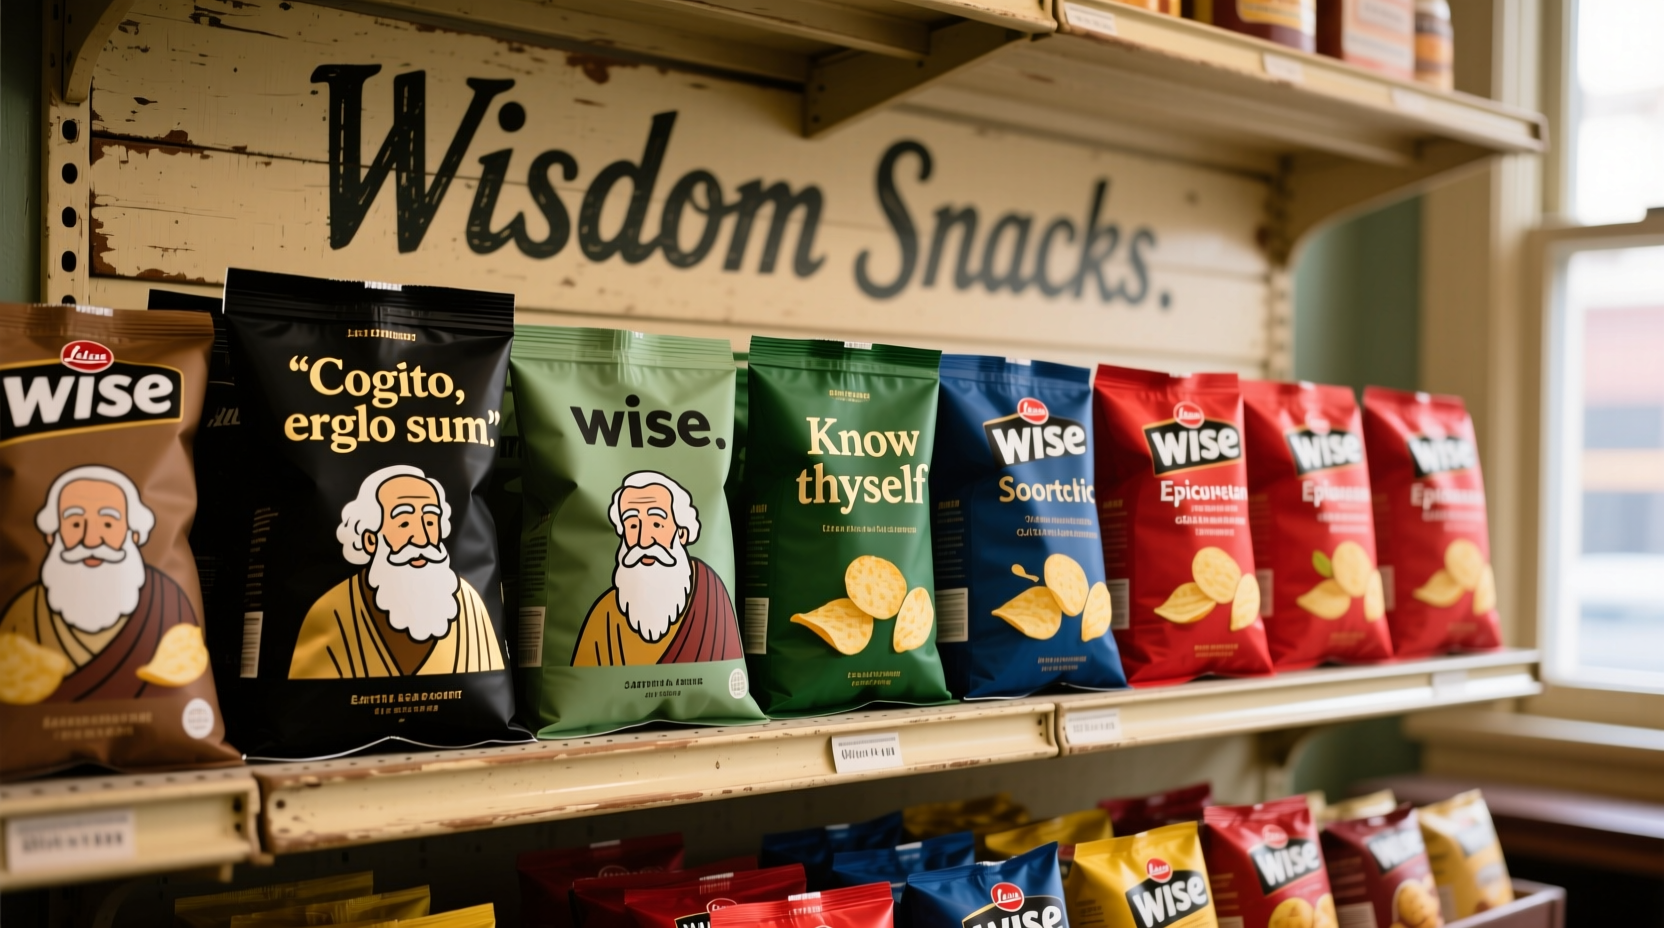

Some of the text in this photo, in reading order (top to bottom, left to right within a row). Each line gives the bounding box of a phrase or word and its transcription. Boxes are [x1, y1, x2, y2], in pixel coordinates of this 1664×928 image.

[310, 63, 1172, 311] Wisdom Snacks.
[289, 355, 466, 408] “Cogito,
[284, 404, 397, 453] erglo
[570, 394, 727, 449] wise.
[805, 416, 920, 457] Know
[796, 463, 929, 515] thyself
